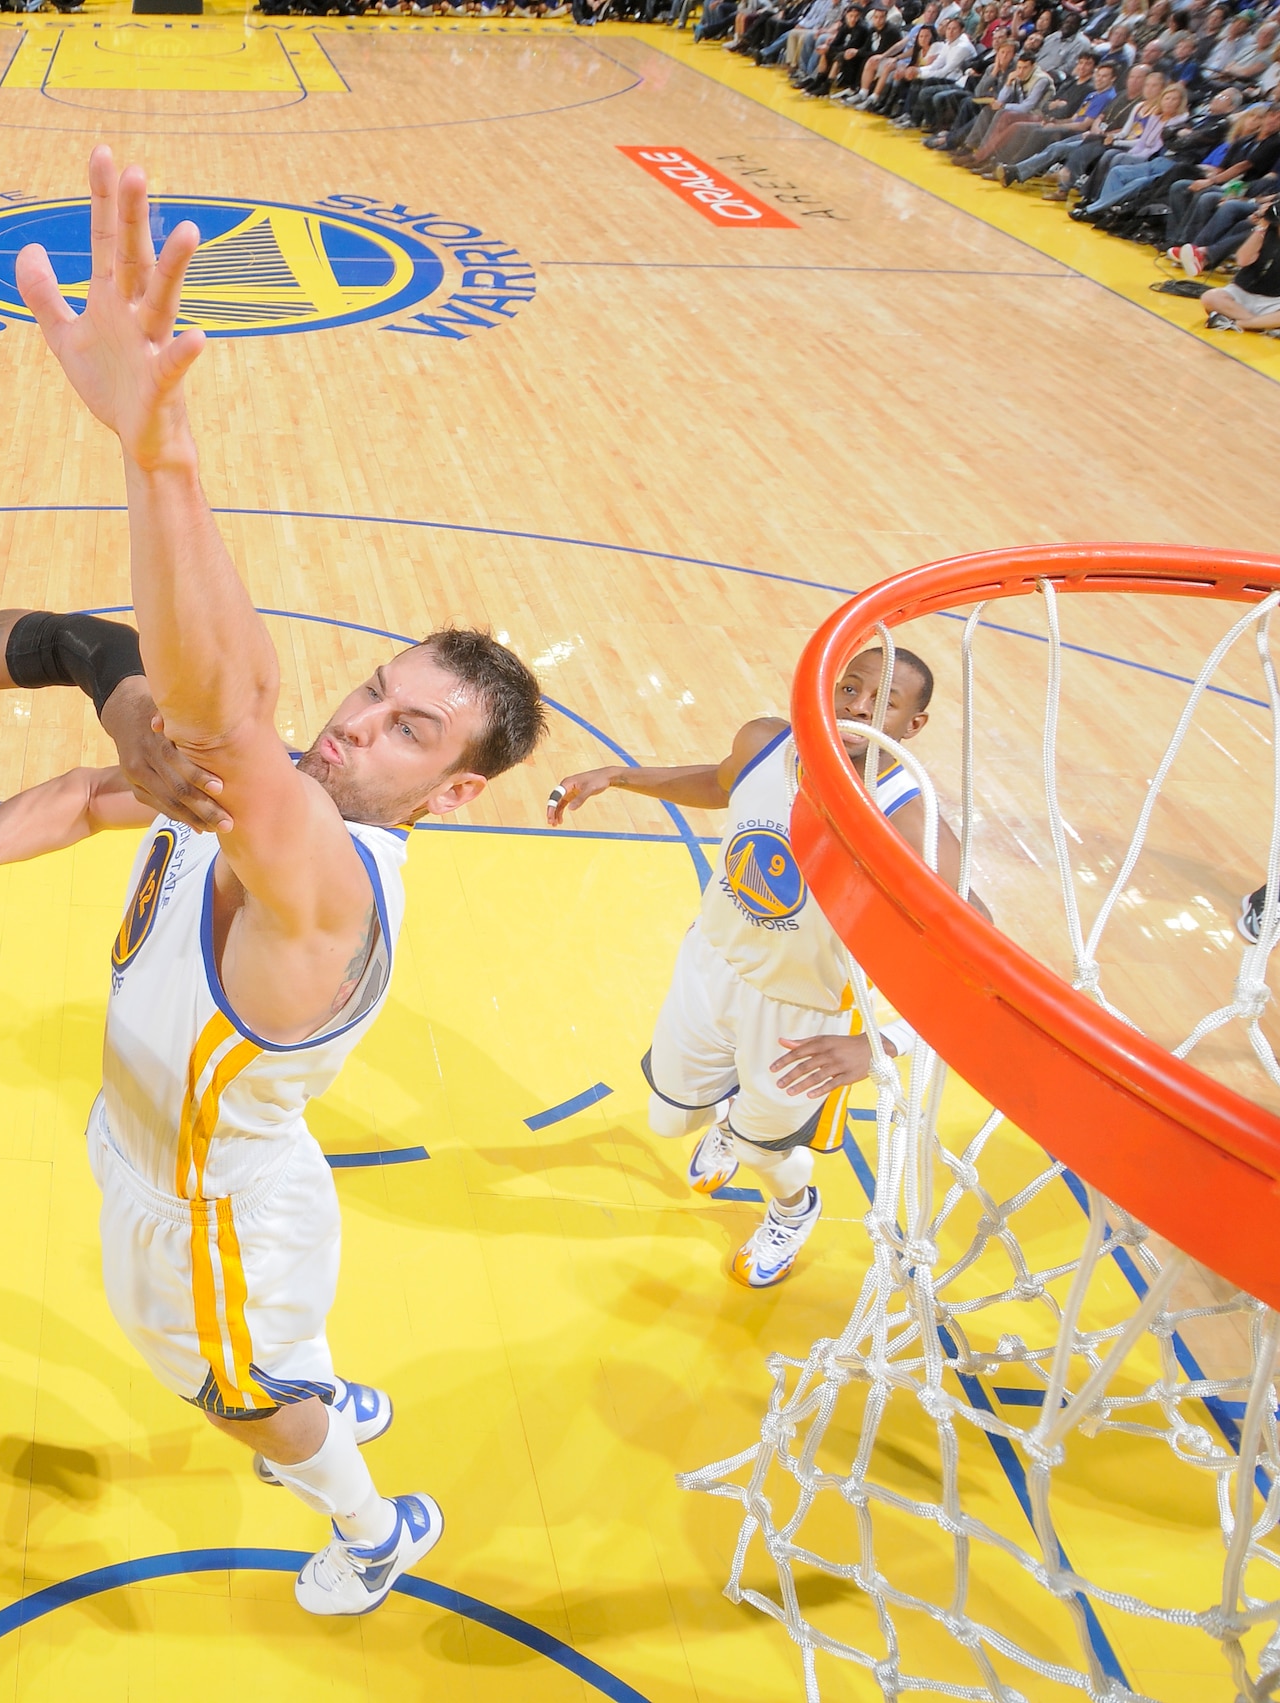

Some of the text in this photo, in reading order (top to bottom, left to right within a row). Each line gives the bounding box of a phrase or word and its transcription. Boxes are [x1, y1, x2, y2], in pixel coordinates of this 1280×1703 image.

[638, 151, 763, 220] ORACLE
[716, 154, 851, 222] ARENA
[314, 194, 537, 341] WARRIORS
[736, 818, 791, 838] GOLDEN
[767, 854, 786, 877] 9
[718, 876, 800, 932] WARRIORS
